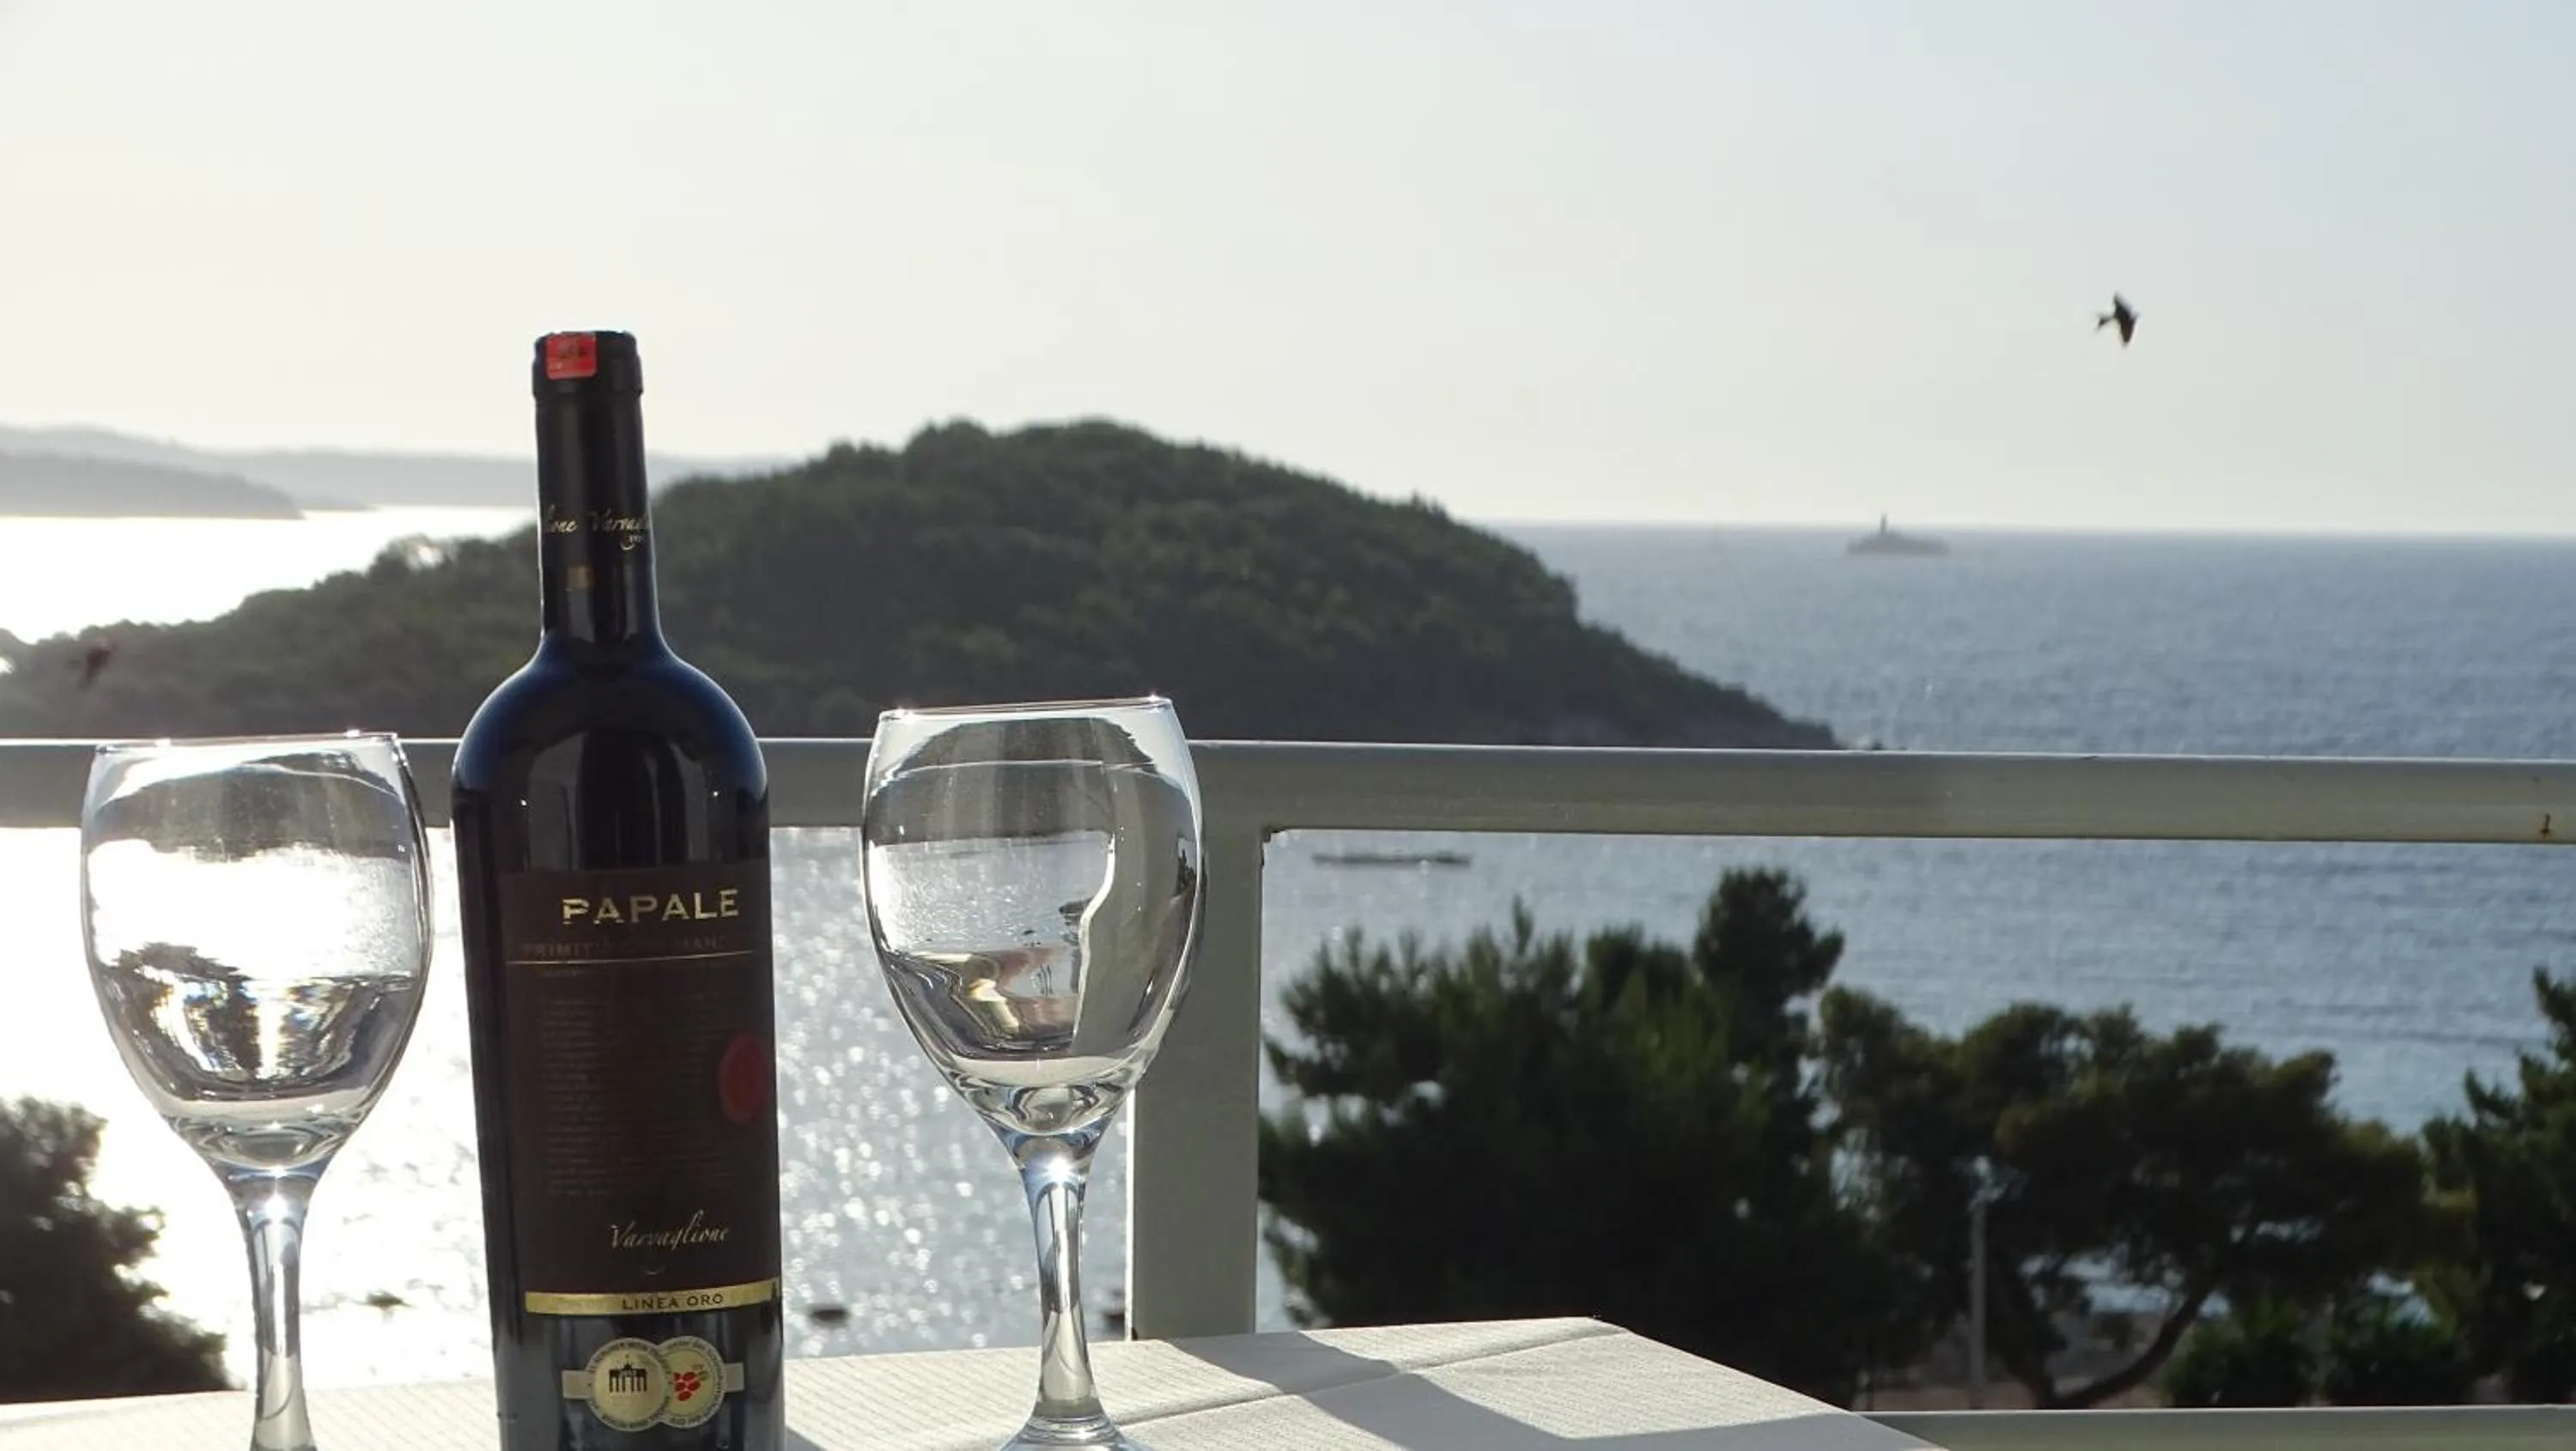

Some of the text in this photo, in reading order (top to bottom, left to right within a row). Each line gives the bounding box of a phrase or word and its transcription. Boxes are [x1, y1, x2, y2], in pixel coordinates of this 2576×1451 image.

[562, 888, 739, 925] PAPALE
[622, 1293, 724, 1310] LINEA ORO
